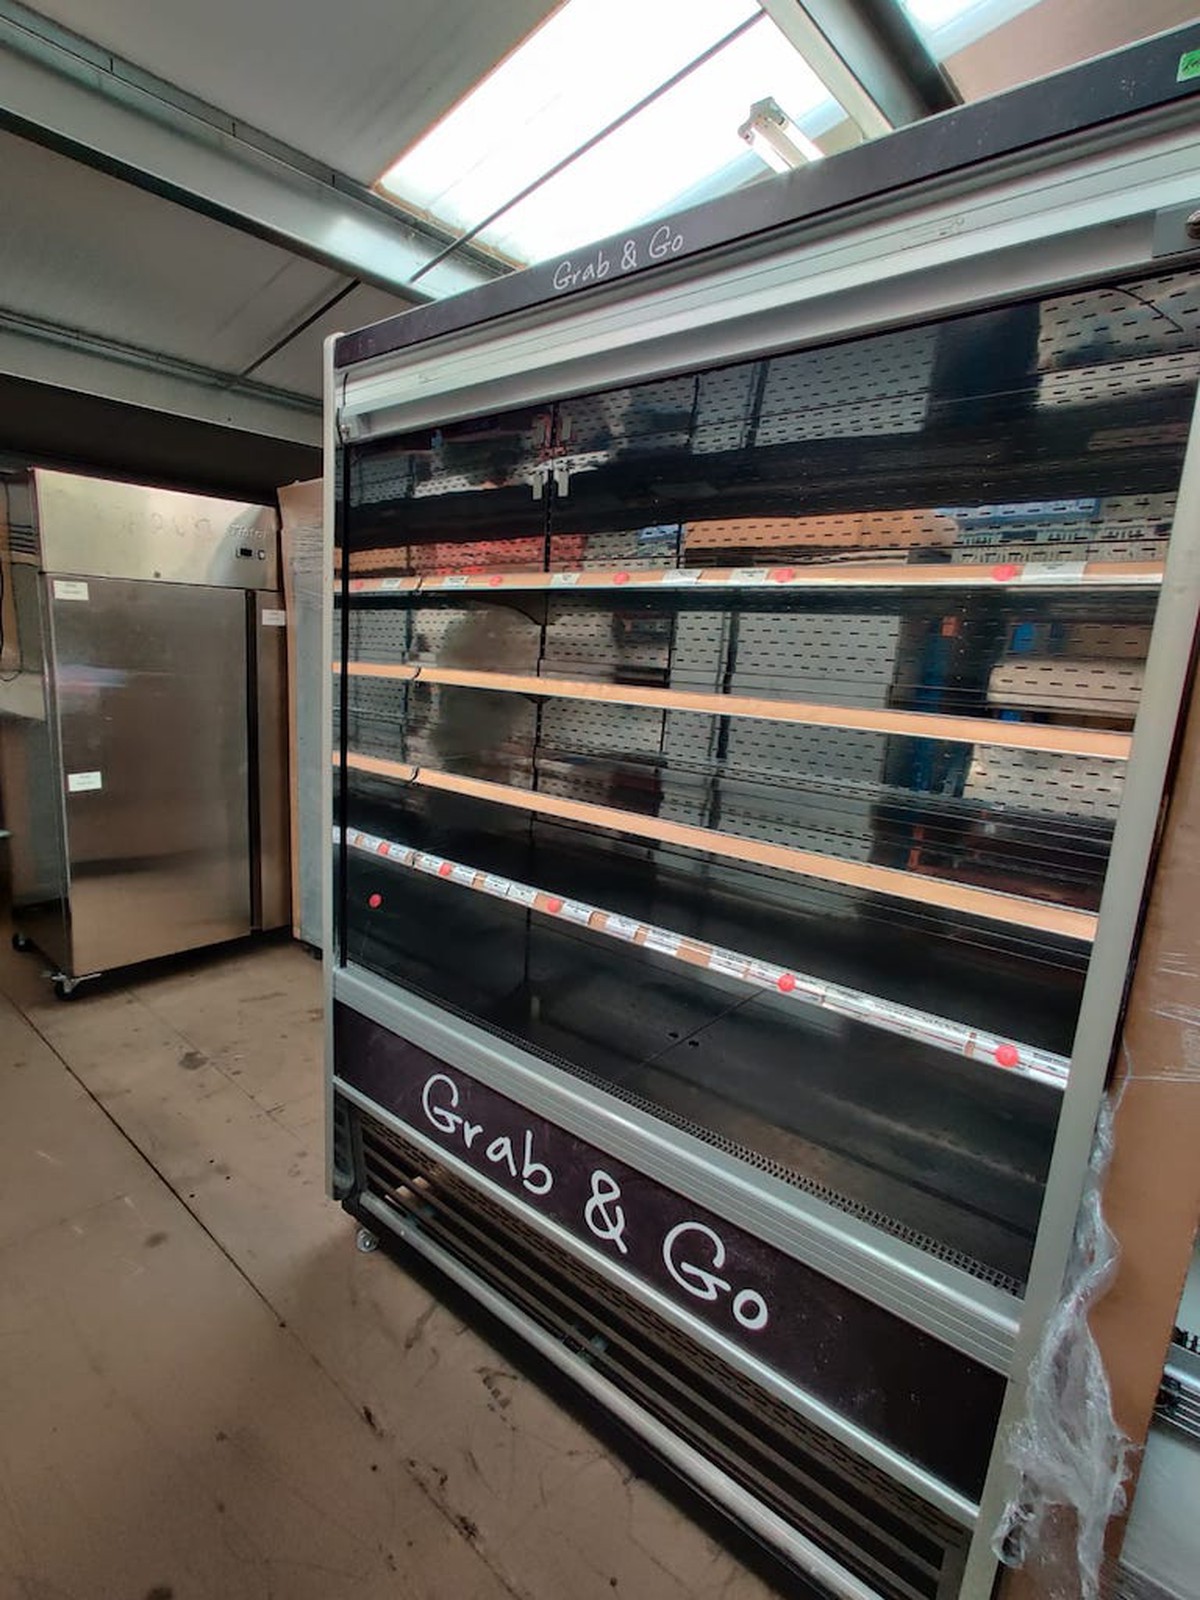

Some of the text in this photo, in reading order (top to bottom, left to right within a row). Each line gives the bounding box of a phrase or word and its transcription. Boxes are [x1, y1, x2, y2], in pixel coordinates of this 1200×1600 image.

[553, 225, 684, 290] Grab & Go
[422, 1073, 769, 1330] Grab & Go
